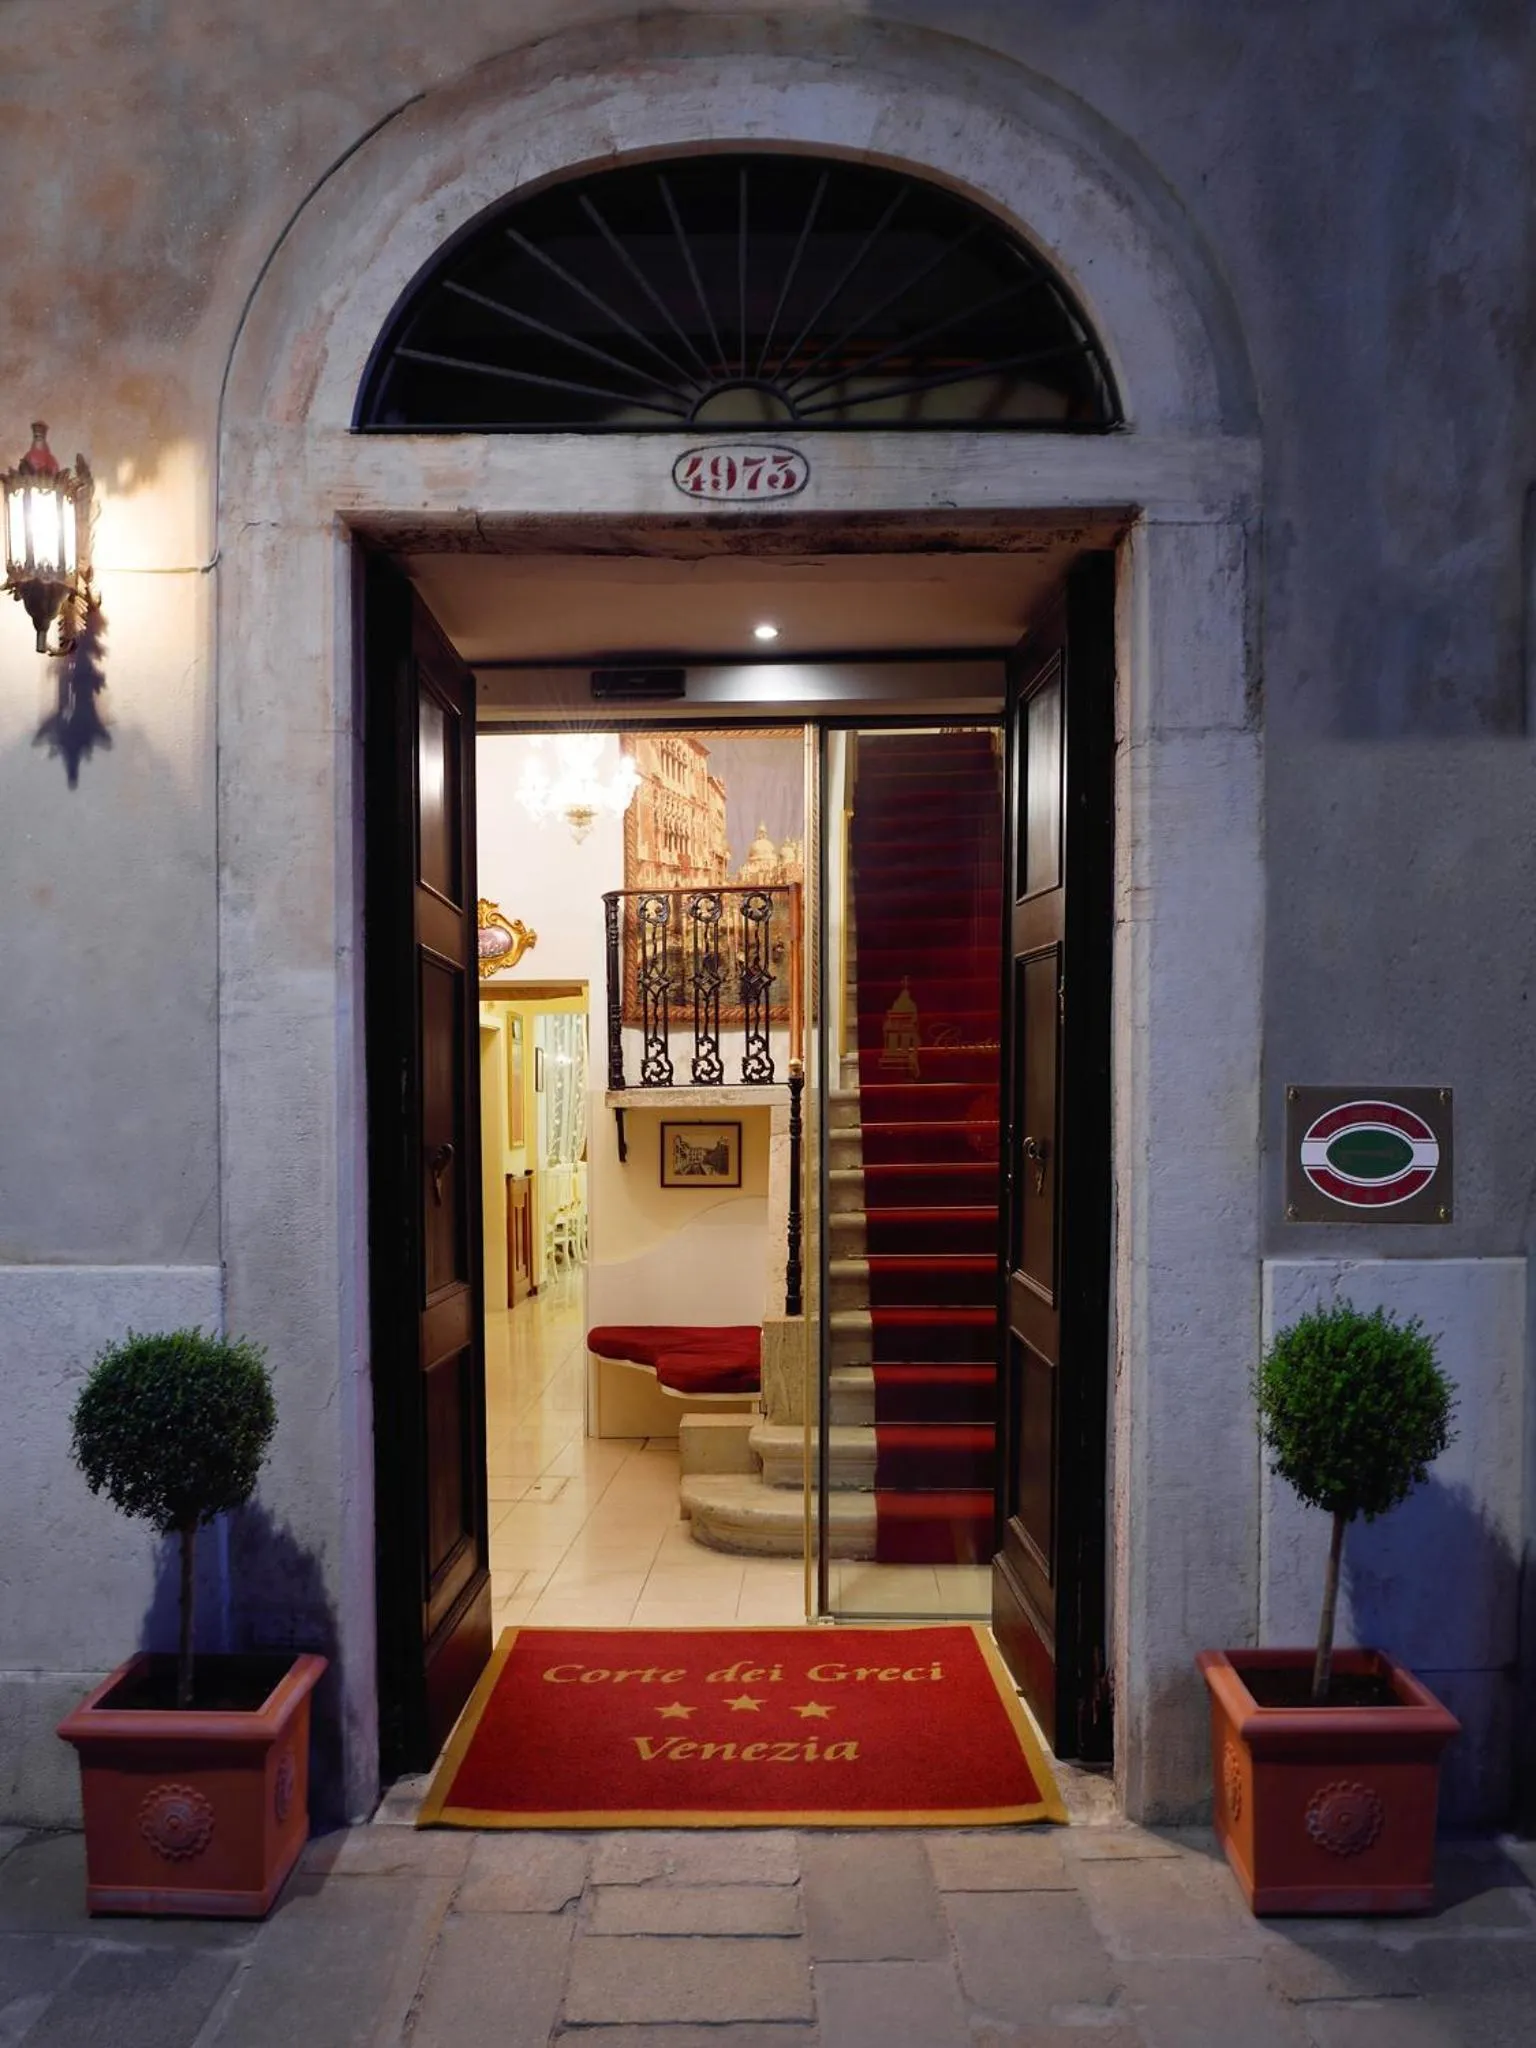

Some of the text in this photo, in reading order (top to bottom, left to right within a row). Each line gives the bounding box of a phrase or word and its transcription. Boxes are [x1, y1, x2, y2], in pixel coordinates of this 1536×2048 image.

[681, 456, 797, 491] 4973
[542, 1661, 946, 1684] Corte dei Greci
[631, 1735, 861, 1761] Venezia
